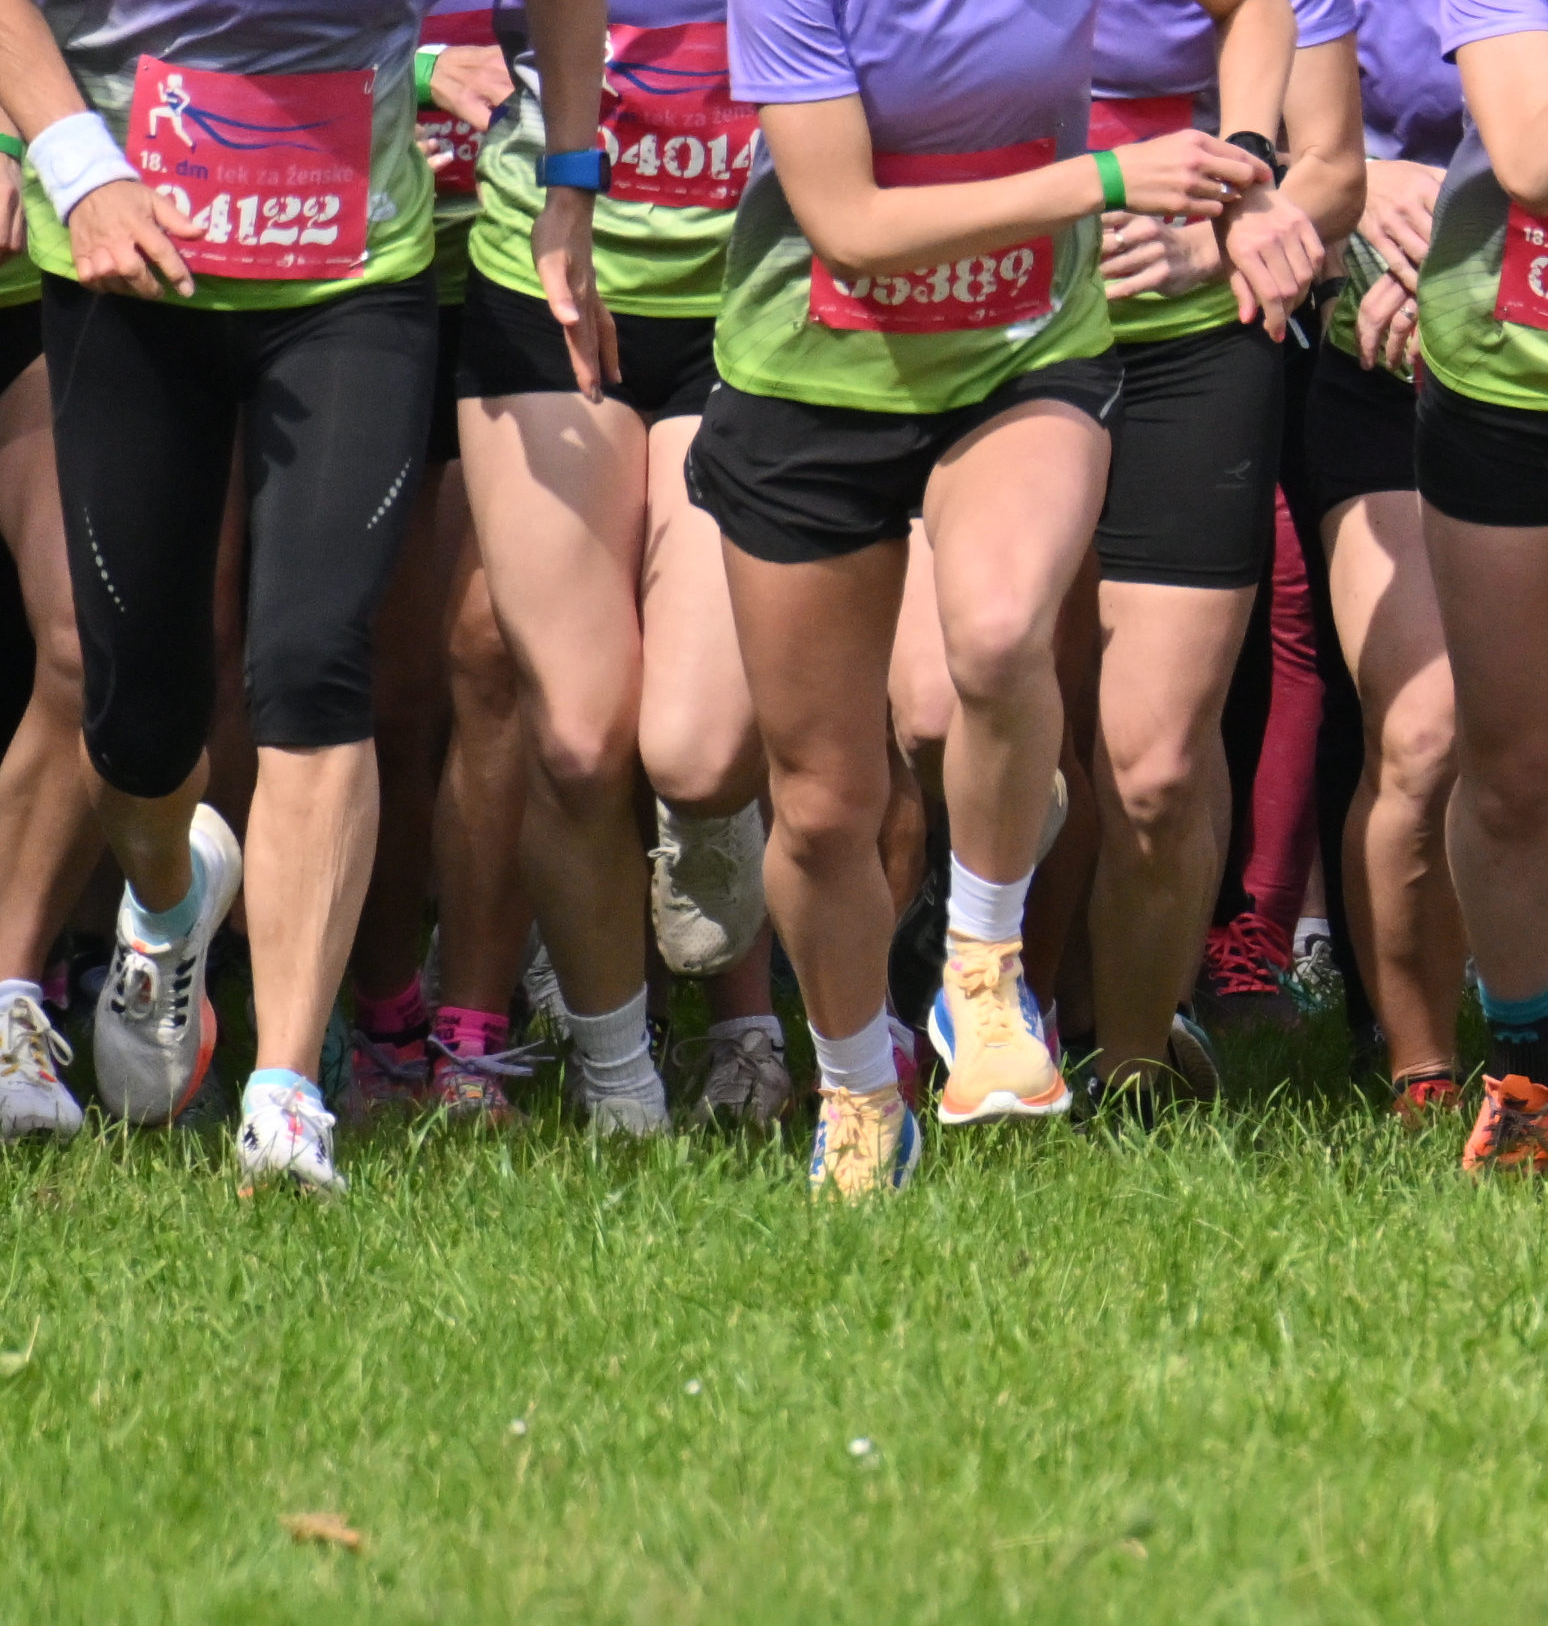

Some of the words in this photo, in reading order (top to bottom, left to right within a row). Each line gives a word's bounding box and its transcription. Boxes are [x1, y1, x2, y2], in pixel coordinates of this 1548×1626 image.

[140, 150, 167, 173] 18.
[176, 160, 208, 180] dm
[217, 165, 248, 183] tek
[257, 169, 279, 184] za
[1524, 227, 1548, 248] 18.
